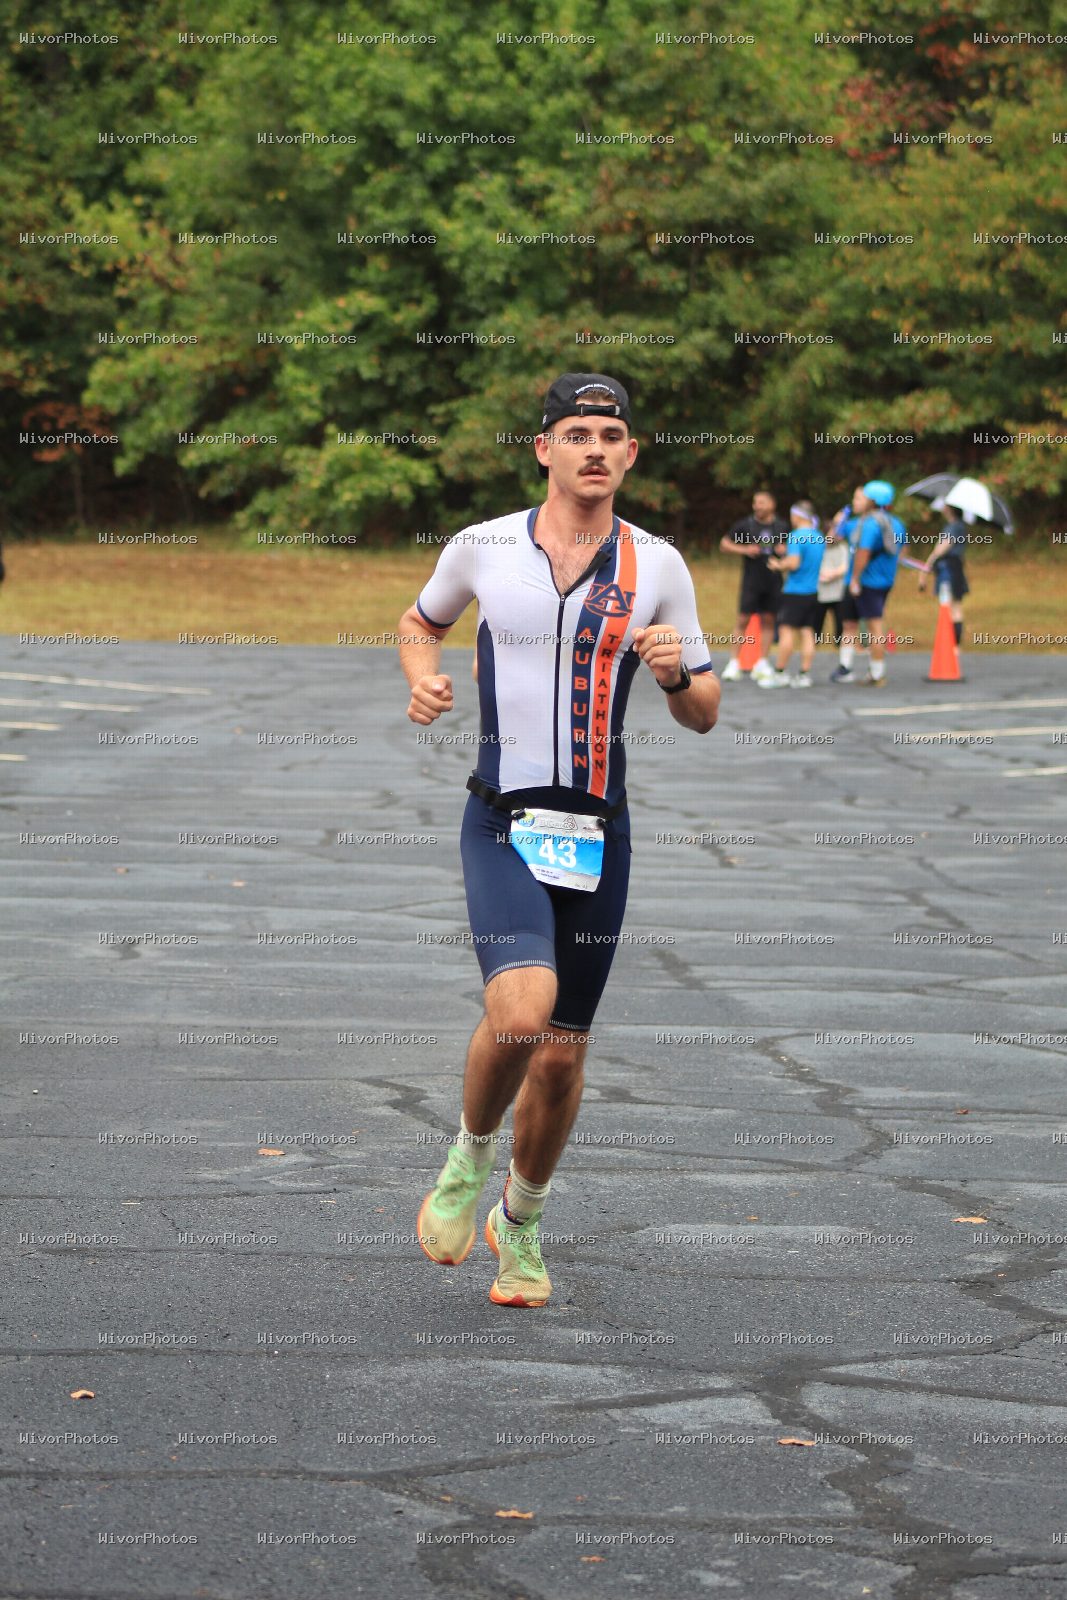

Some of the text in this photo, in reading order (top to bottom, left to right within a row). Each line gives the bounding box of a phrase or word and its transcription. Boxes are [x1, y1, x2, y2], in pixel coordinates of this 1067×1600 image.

[573, 627, 592, 769] AUBURN
[594, 633, 619, 770] TRIATHLON
[538, 838, 577, 868] 43
